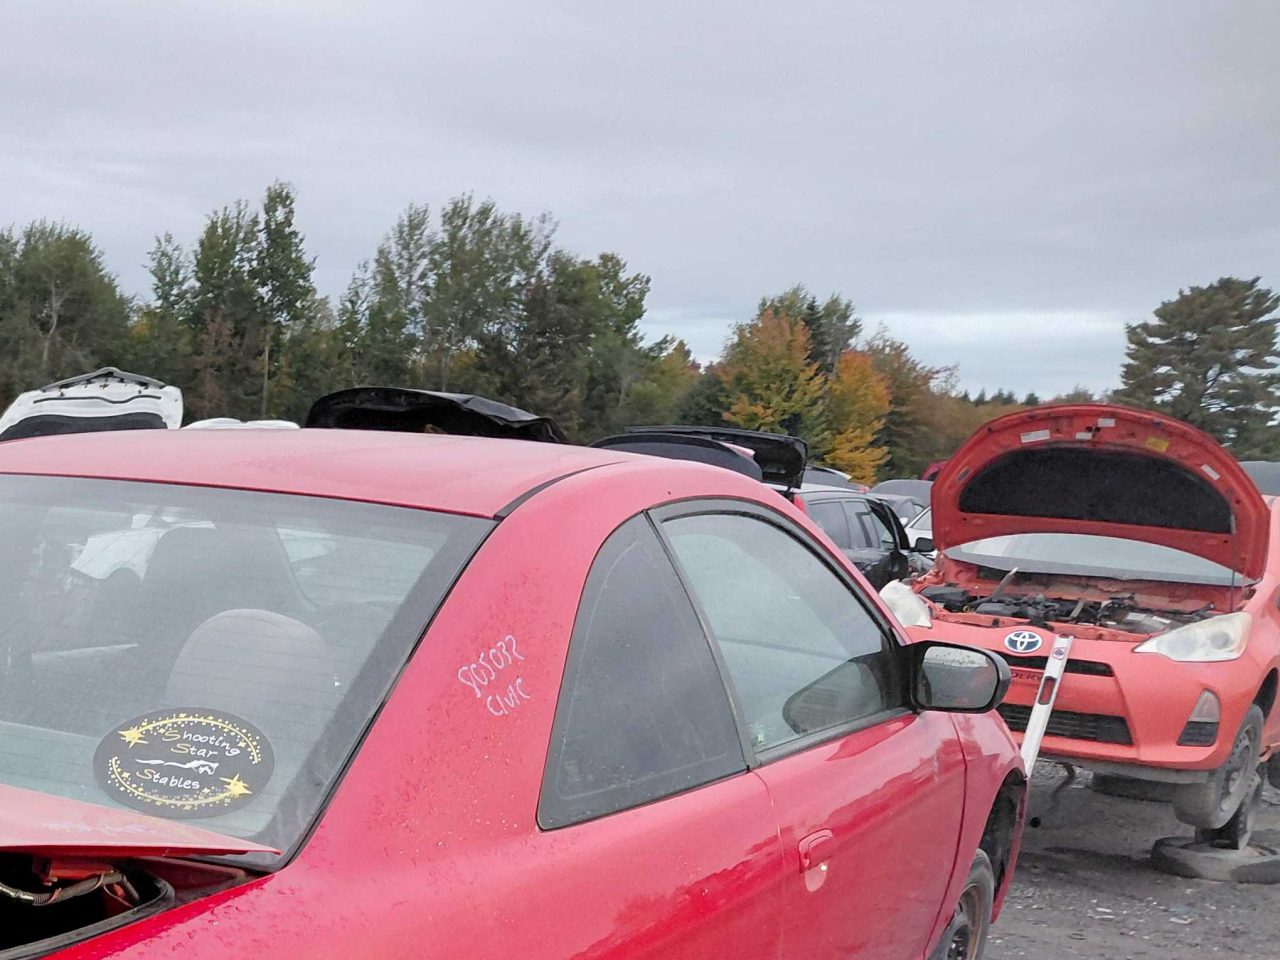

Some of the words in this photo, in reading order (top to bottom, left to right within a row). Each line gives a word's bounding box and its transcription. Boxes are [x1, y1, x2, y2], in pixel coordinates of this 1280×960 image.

[162, 729, 241, 757] Shooting
[171, 743, 219, 759] Star
[136, 768, 201, 790] Stables
